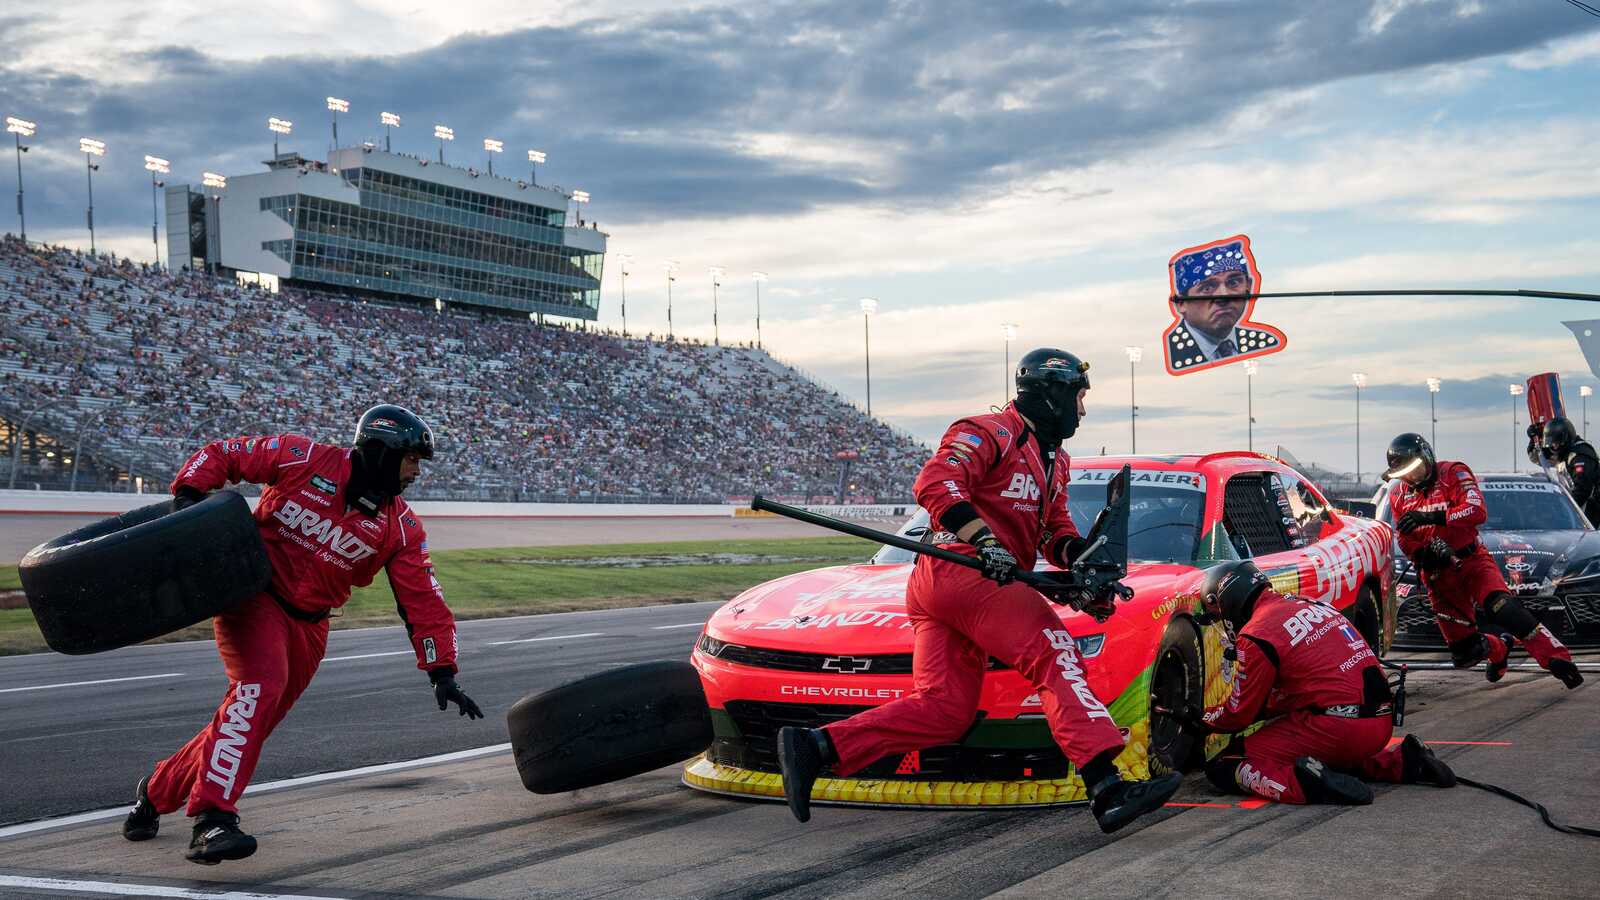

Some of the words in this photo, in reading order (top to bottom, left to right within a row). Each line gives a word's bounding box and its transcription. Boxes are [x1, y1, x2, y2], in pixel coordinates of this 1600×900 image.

[1484, 483, 1547, 491] BURTON
[273, 499, 379, 563] BRANDT
[1504, 581, 1544, 595] upra
[1283, 602, 1341, 647] BRAN
[780, 685, 904, 699] CHEVROLET
[1043, 628, 1118, 728] BRANDT
[204, 682, 261, 799] BRANDT
